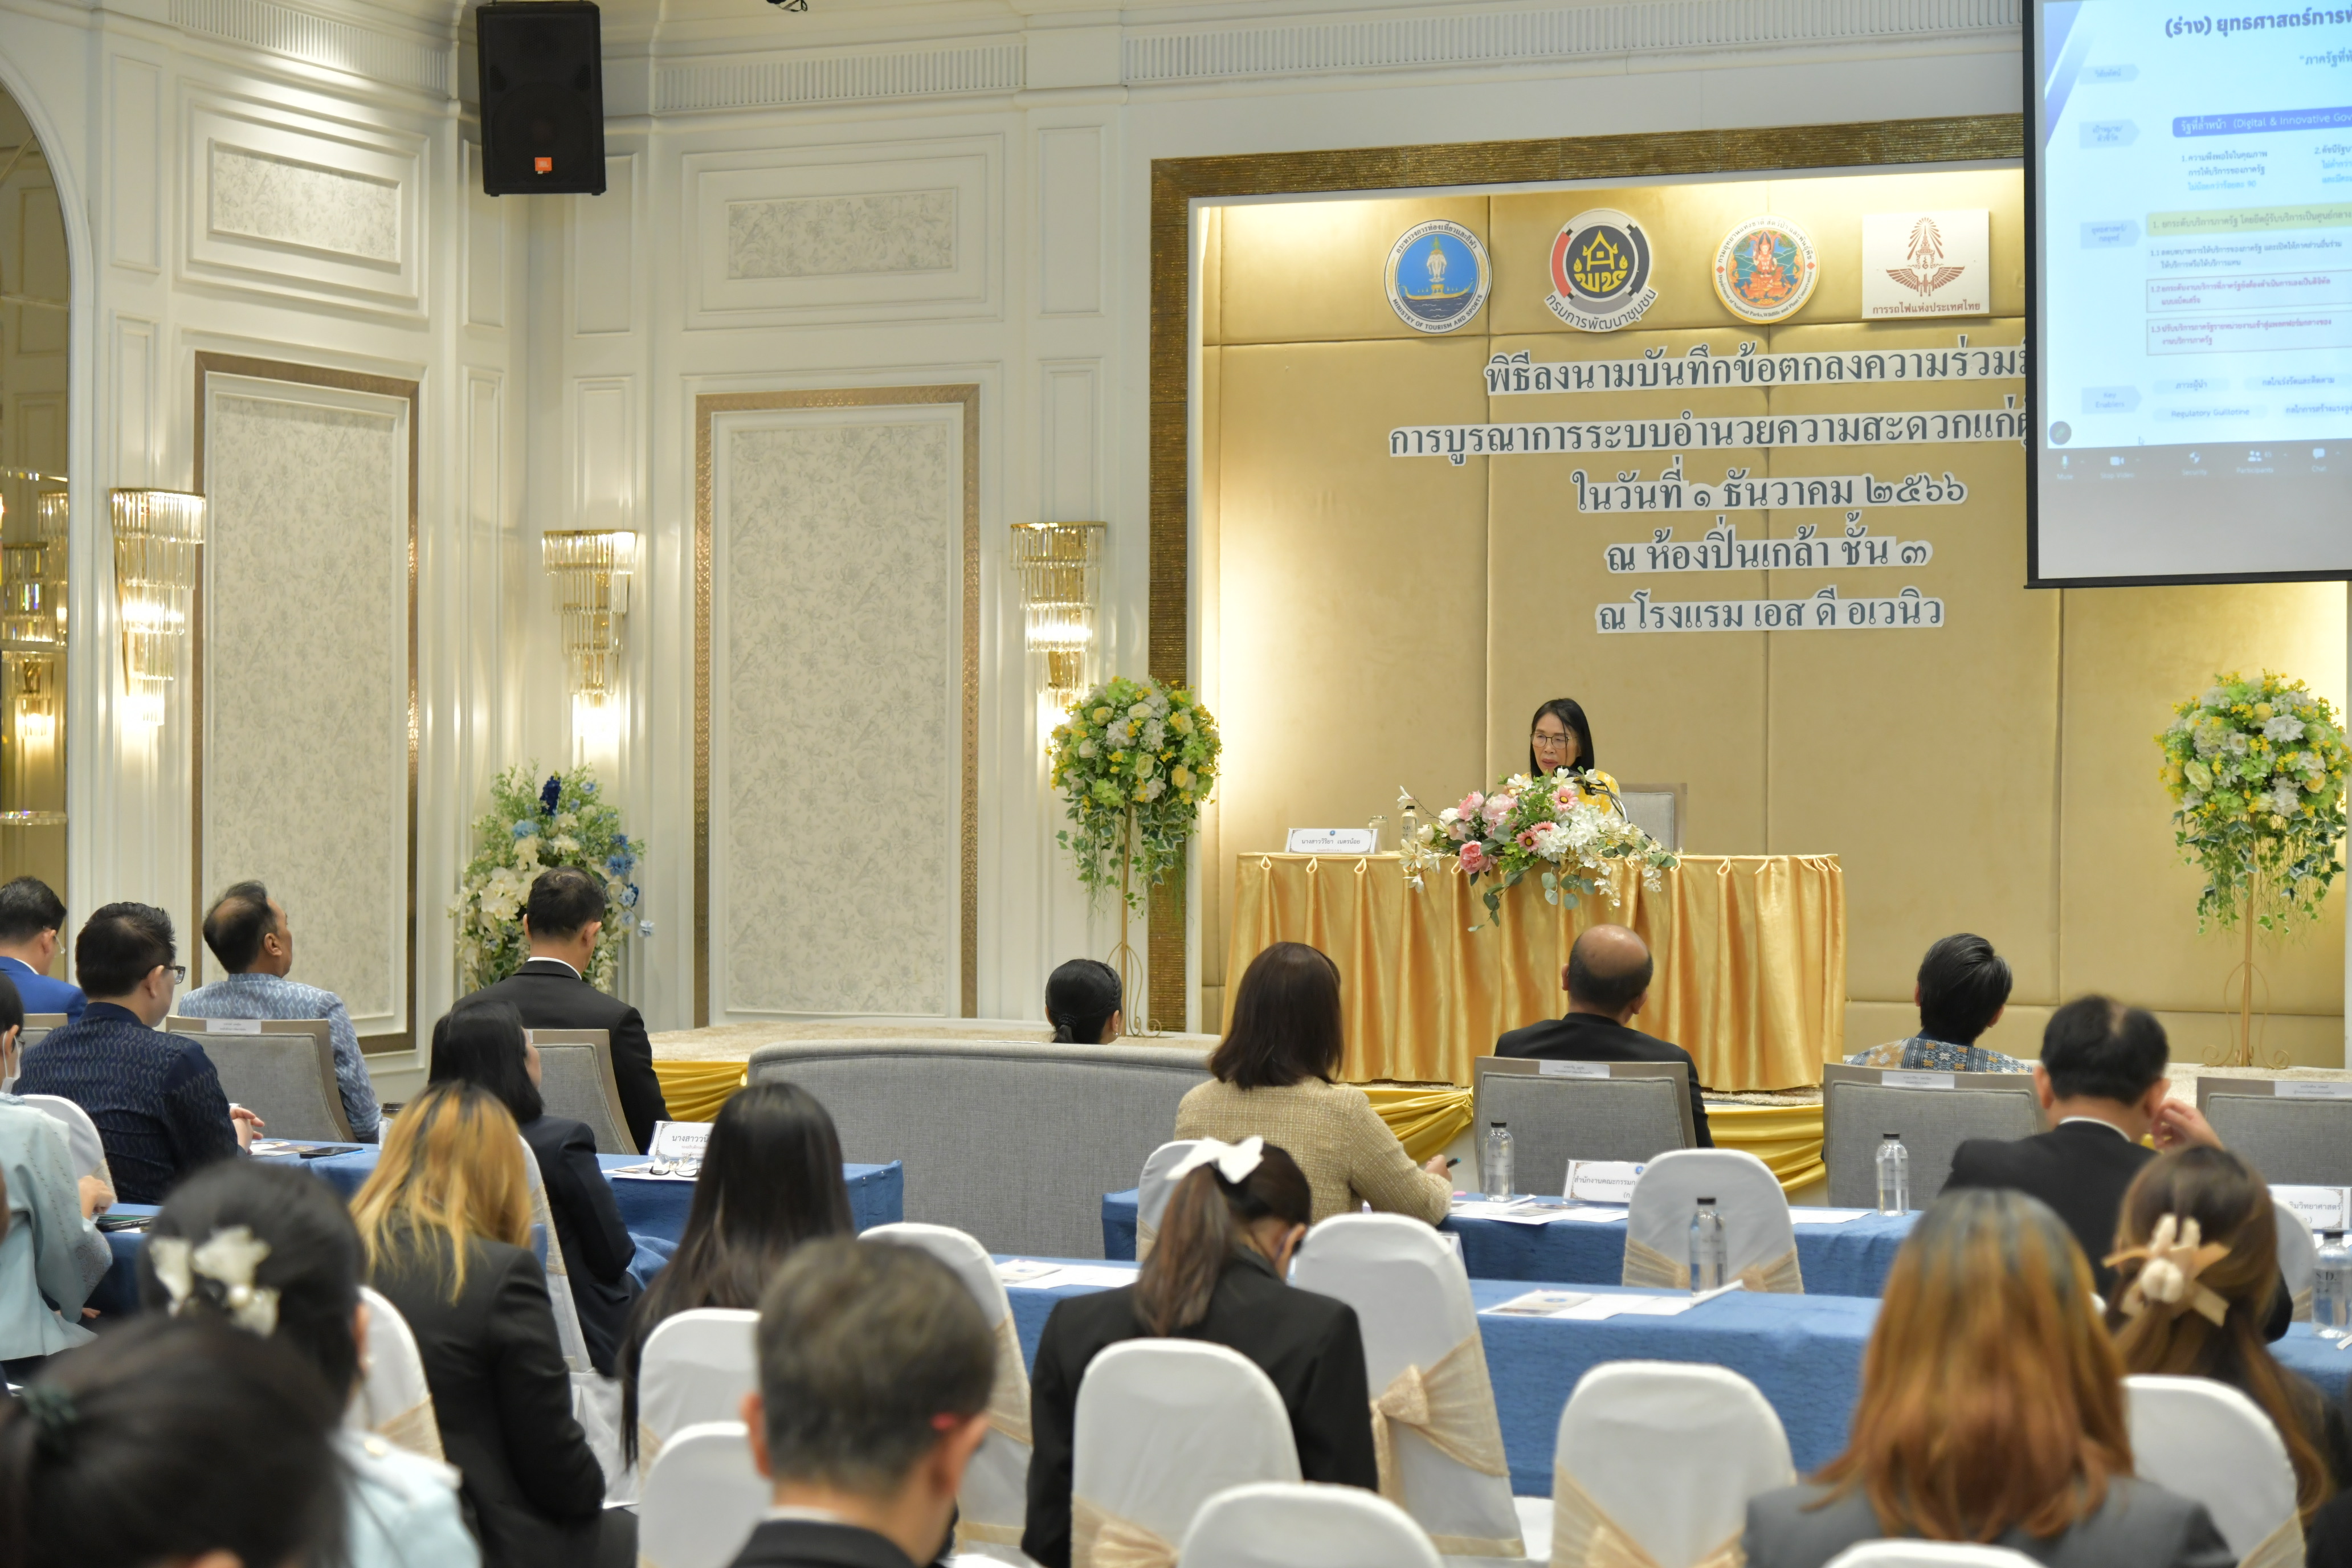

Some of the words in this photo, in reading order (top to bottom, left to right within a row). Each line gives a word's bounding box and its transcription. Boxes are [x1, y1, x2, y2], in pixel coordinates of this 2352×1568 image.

[2165, 16, 2212, 38] (ร่าง)
[2270, 117, 2278, 126] &
[2281, 115, 2330, 125] Innovative
[1393, 298, 1415, 324] MINISTRY
[1425, 322, 1452, 330] TOURISM
[1454, 315, 1467, 326] AND
[1466, 293, 1483, 317] SPORTS
[1546, 289, 1656, 329] กรมการพัฒนาชุมชน
[1873, 299, 1981, 315] การรถไฟแห่งประเทศไทย
[2171, 409, 2211, 418] Regulatory
[1571, 456, 1681, 511] ในวันที่
[1694, 490, 1711, 508] ๑
[1724, 469, 1852, 507] ธันวาคม
[1865, 473, 1964, 503] ๒๕๖๖
[1608, 546, 1635, 570] ณ
[1647, 516, 1829, 570] ห้องปิ่นเกล้า
[1841, 511, 1888, 565] ชั้น
[1901, 545, 1927, 564] ๓
[1599, 606, 1626, 630] ณ
[1634, 591, 1743, 629] โรงแรม
[1754, 602, 1806, 627] เอส
[1816, 587, 1836, 626] ดี
[1848, 587, 1941, 625] อเวนิว
